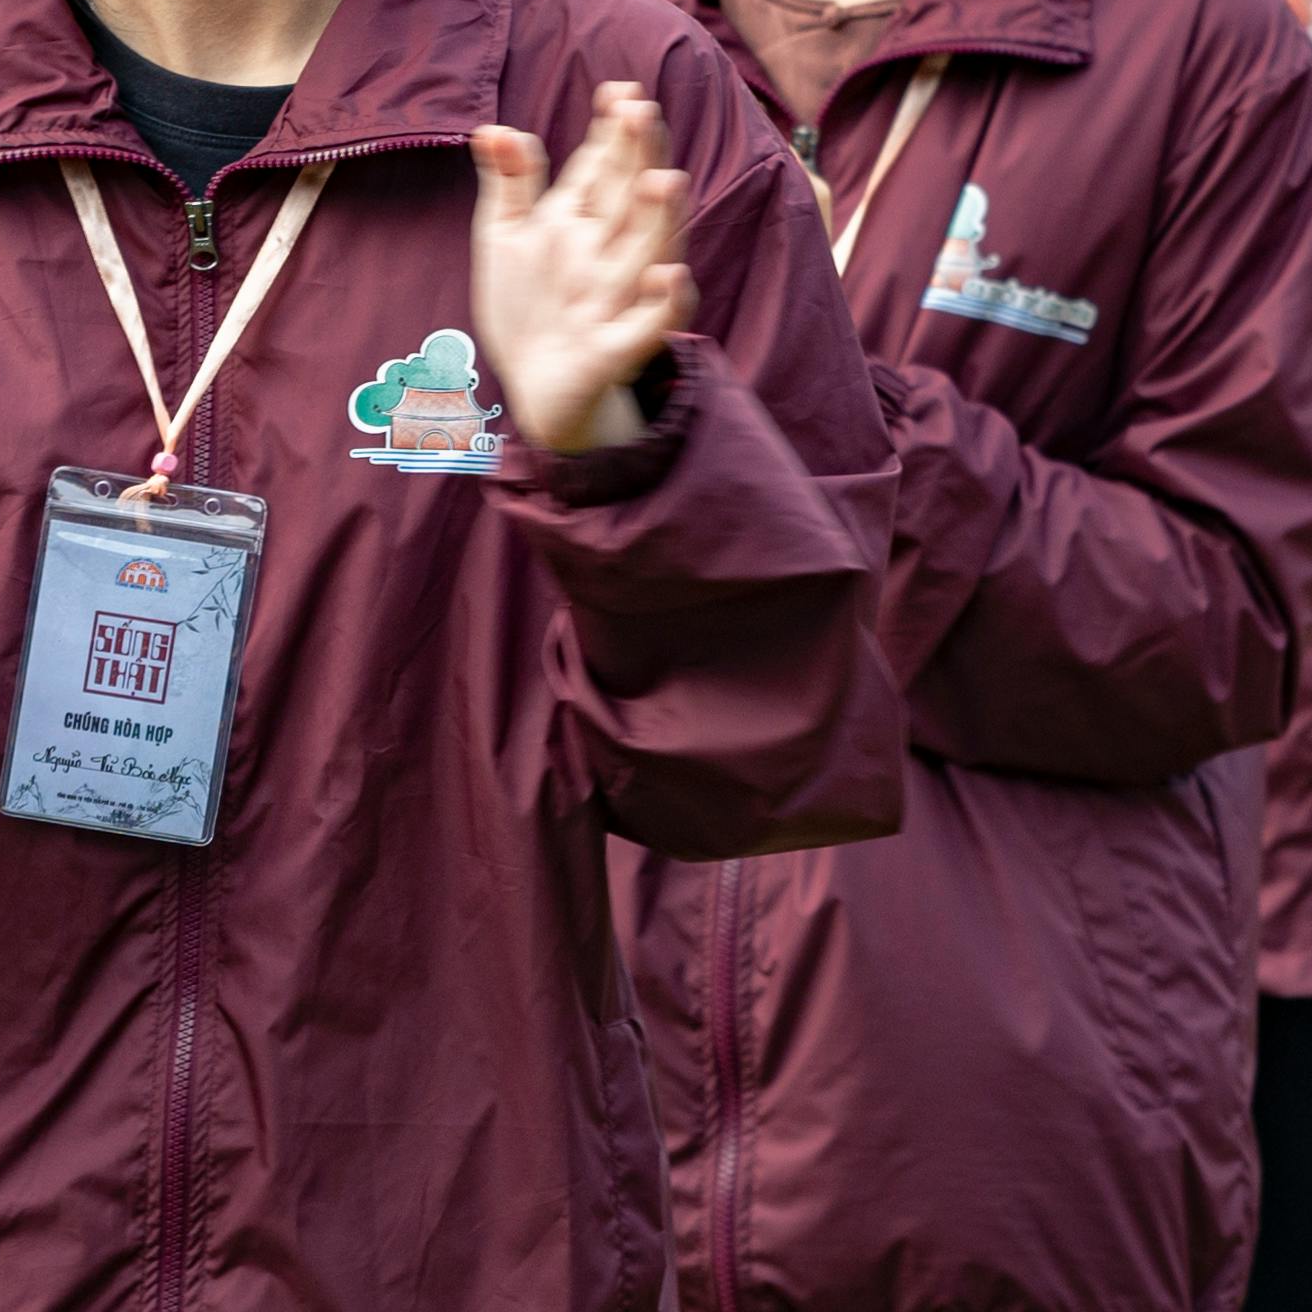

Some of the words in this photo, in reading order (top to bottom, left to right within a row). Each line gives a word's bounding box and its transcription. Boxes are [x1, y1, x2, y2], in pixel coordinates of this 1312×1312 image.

[93, 656, 165, 696] THẬT
[64, 711, 110, 734] CHÚNG
[113, 718, 141, 740] HÒA
[145, 724, 174, 746] HỢP
